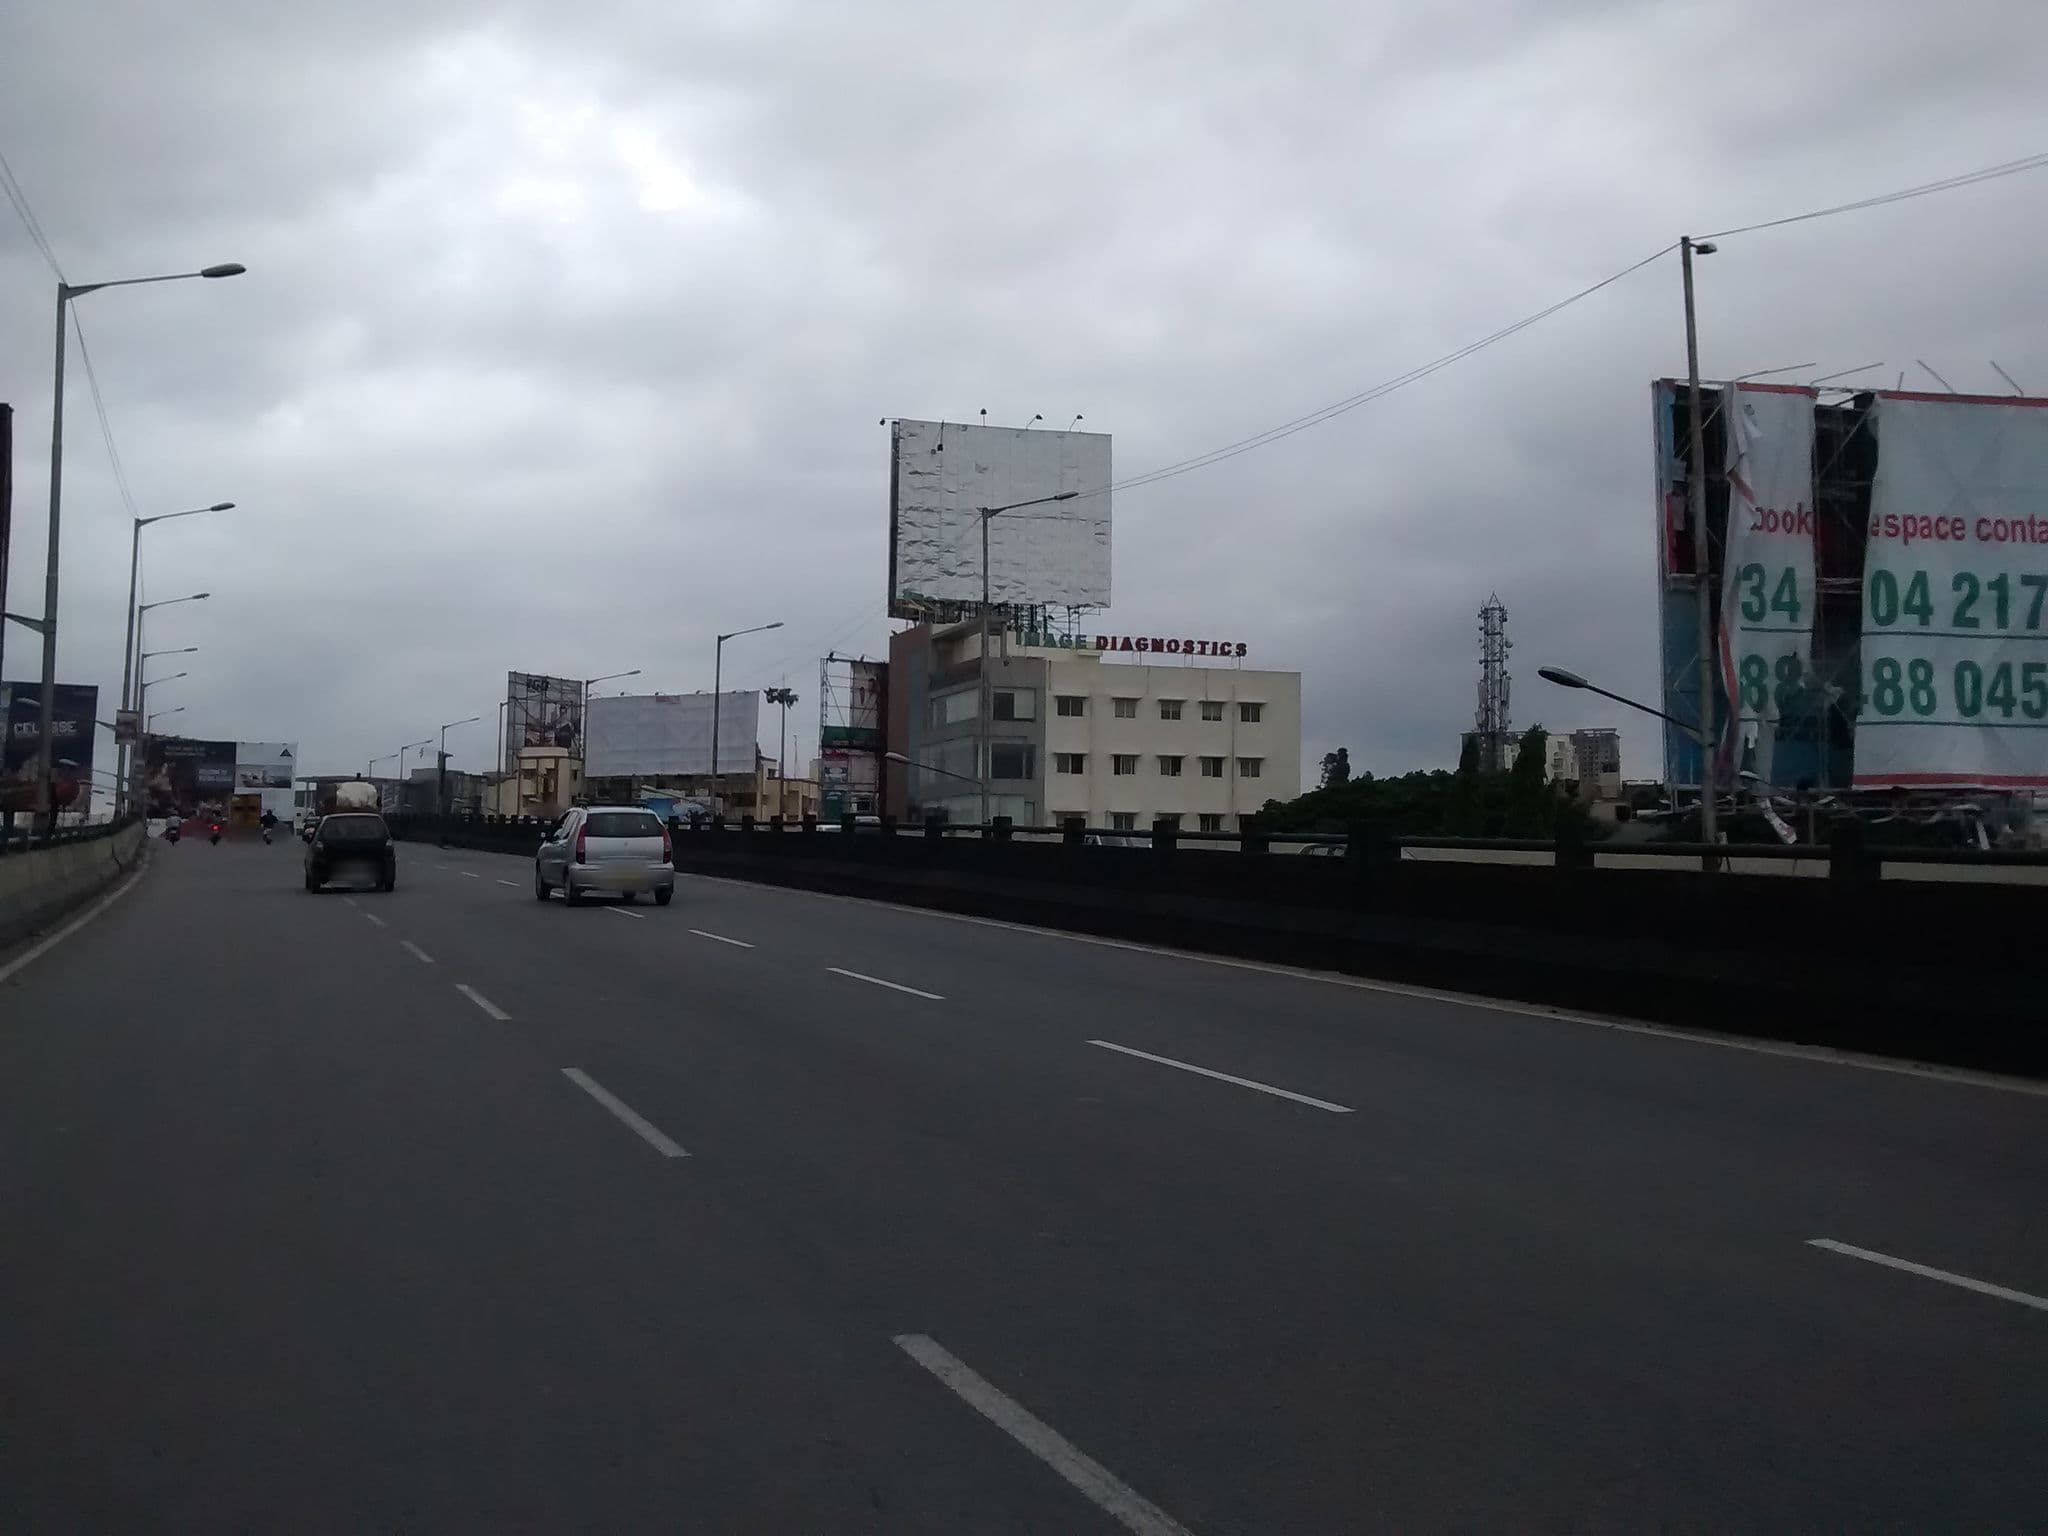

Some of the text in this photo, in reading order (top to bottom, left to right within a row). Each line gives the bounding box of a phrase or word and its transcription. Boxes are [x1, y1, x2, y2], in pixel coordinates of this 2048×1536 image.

[1870, 569, 1934, 626] 04
[1952, 571, 2048, 630] 217
[1015, 631, 1247, 657] IMAGE DIAGNOSTICS
[1860, 657, 1937, 716] 88
[1954, 660, 2048, 719] 045
